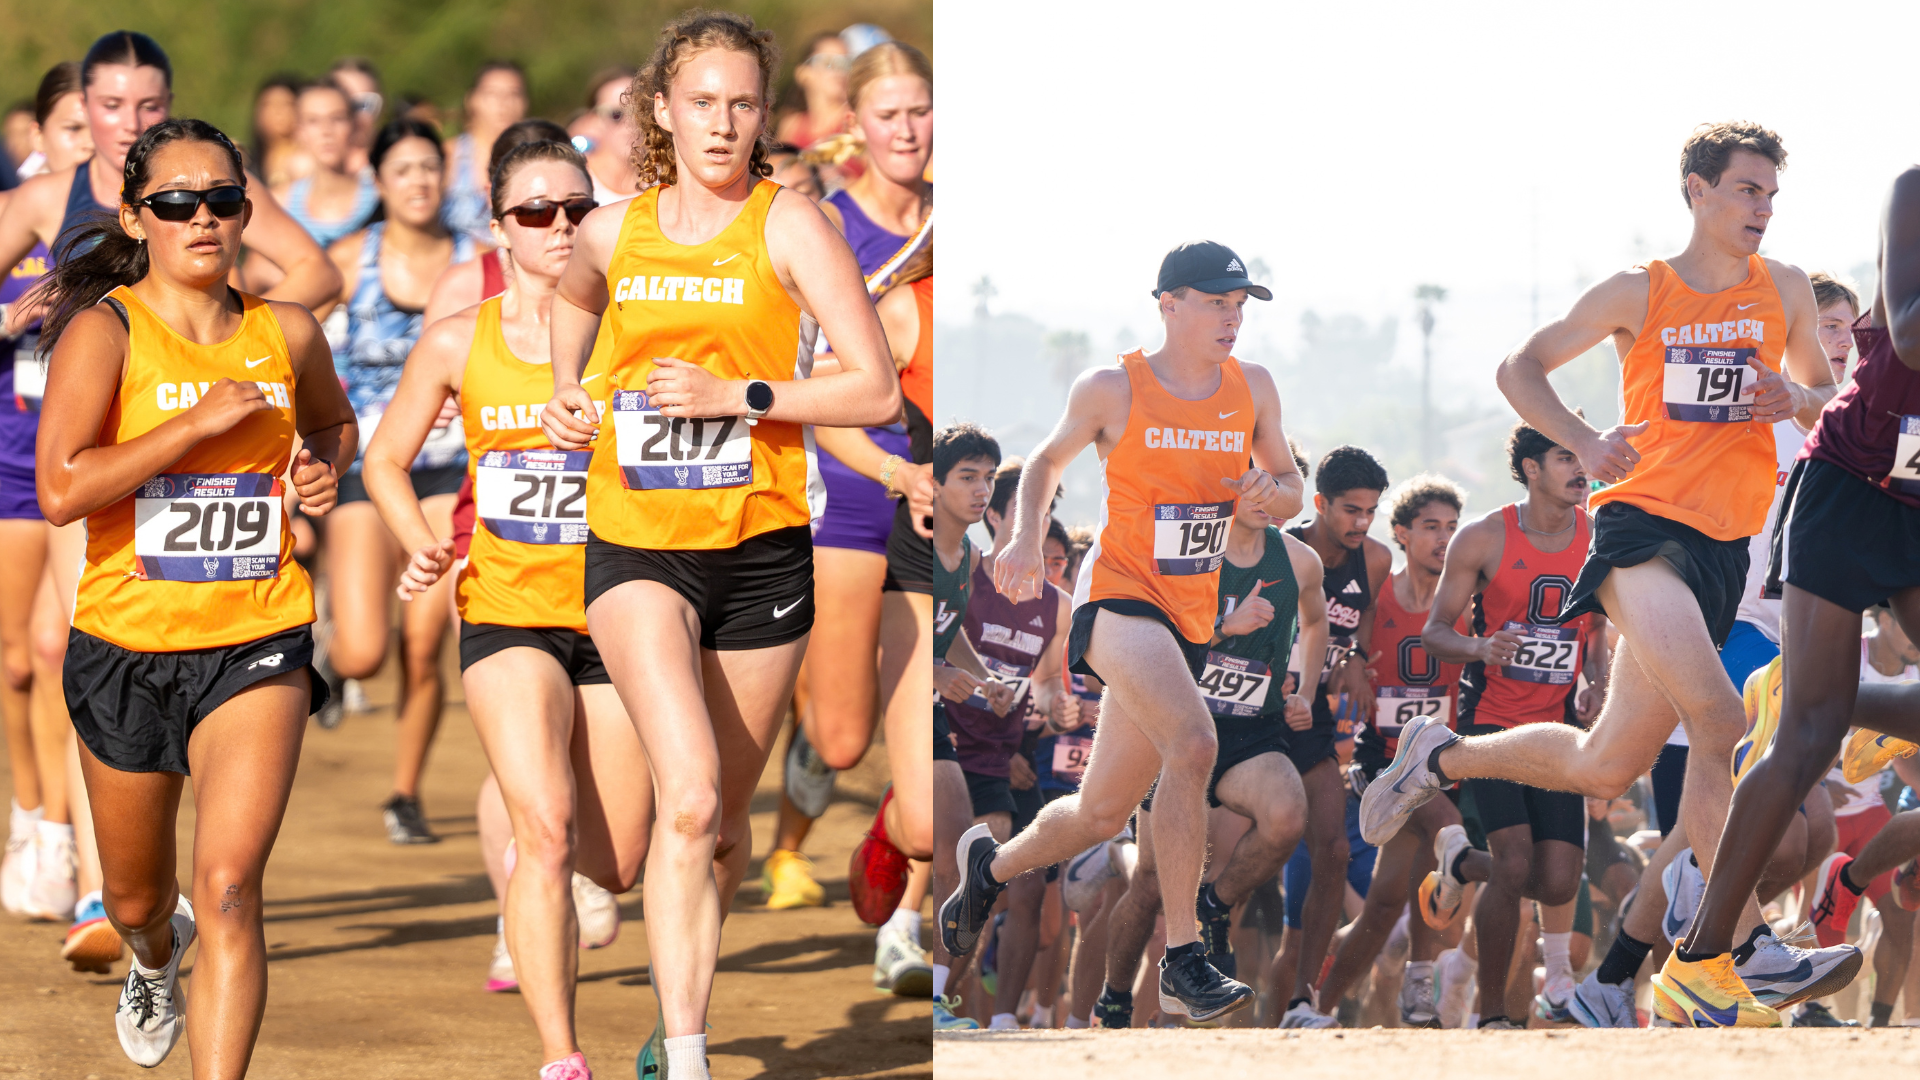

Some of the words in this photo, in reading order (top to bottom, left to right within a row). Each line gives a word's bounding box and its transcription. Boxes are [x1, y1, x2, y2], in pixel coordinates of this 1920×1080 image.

[615, 275, 745, 305] CALTECH
[1661, 318, 1764, 346] CALTECH
[1696, 367, 1744, 402] 191
[640, 414, 738, 461] 207
[1144, 427, 1246, 453] CALTECH
[722, 470, 738, 478] YOUR
[738, 463, 749, 471] FOR
[194, 487, 236, 497] RESULTS
[196, 477, 238, 486] FINISHED
[509, 473, 588, 518] 212
[1192, 512, 1218, 520] RESULTS
[1194, 505, 1220, 513] FINISHED
[163, 501, 270, 552] 209
[1179, 520, 1227, 556] 190
[266, 556, 277, 564] FOR
[1514, 640, 1573, 670] 622
[1200, 669, 1265, 702] 497
